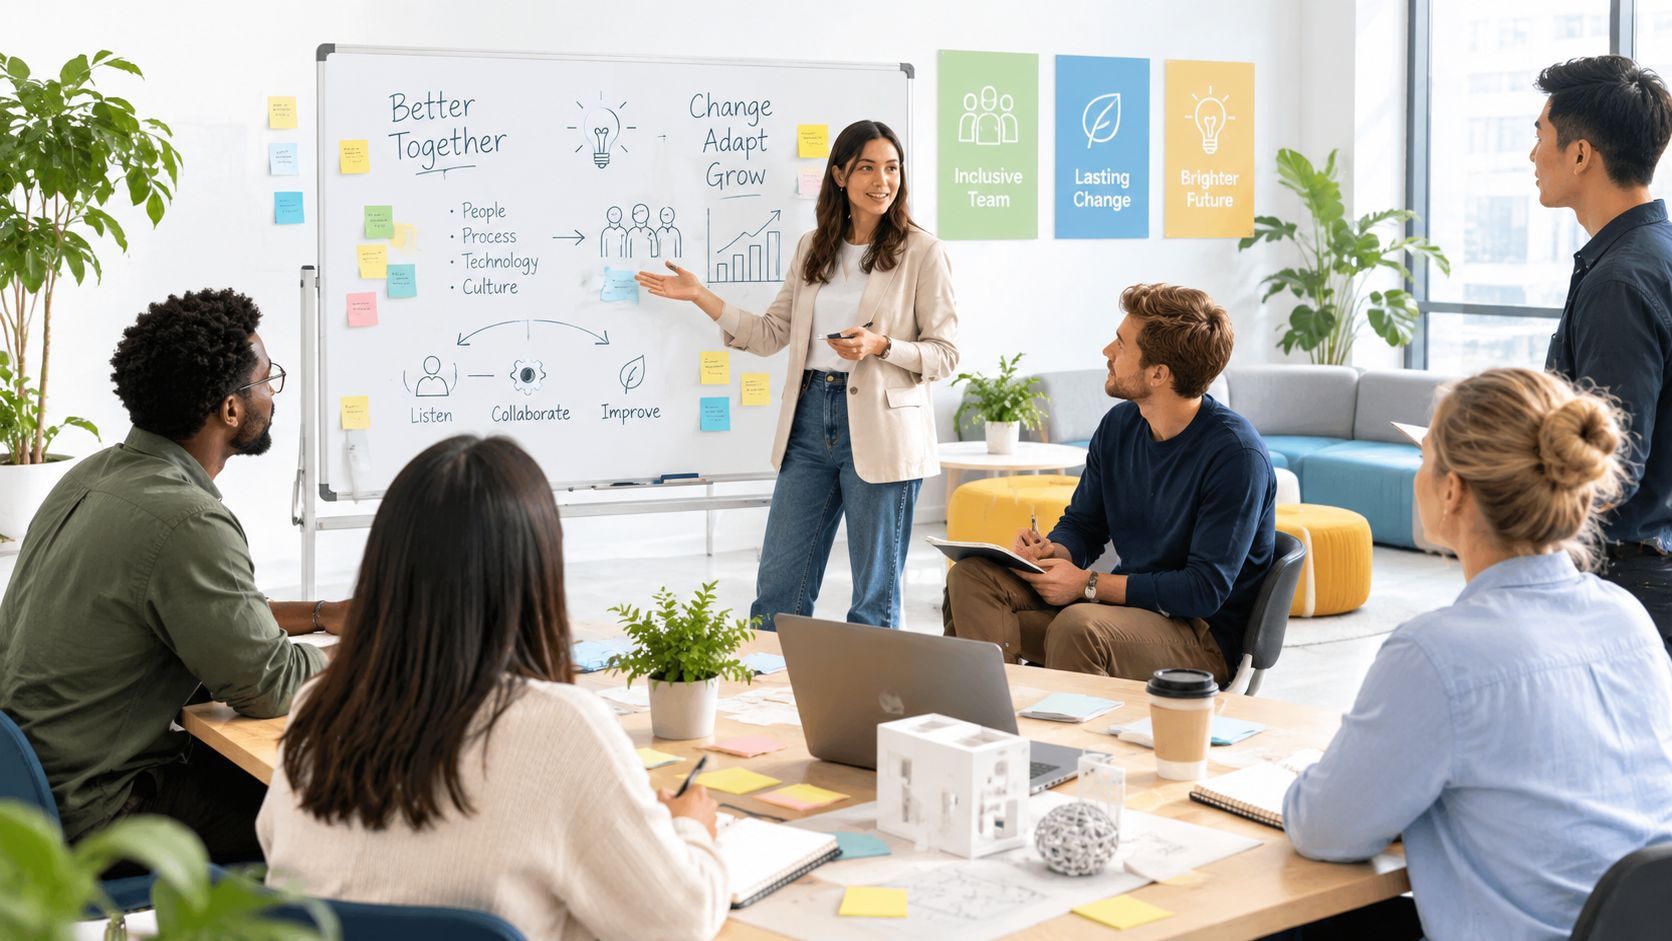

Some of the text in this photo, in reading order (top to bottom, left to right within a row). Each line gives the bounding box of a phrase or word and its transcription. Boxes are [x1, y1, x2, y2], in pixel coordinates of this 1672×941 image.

[388, 90, 476, 123] Better
[689, 91, 773, 128] Change
[387, 126, 508, 170] Together
[702, 126, 769, 161] Adapt
[705, 161, 766, 191] Grow
[954, 167, 1023, 185] Inclusive
[1075, 167, 1130, 189] Lasting
[1180, 169, 1240, 190] Brighter
[967, 190, 1011, 208] Team
[1073, 190, 1132, 212] Change
[1186, 191, 1234, 208] Future
[462, 201, 507, 224] People
[462, 226, 517, 244] Process
[461, 251, 539, 276] Technology
[462, 277, 519, 295] Culture
[411, 406, 453, 424] Listen
[491, 404, 571, 423] Collaborate
[600, 402, 661, 426] Improve
